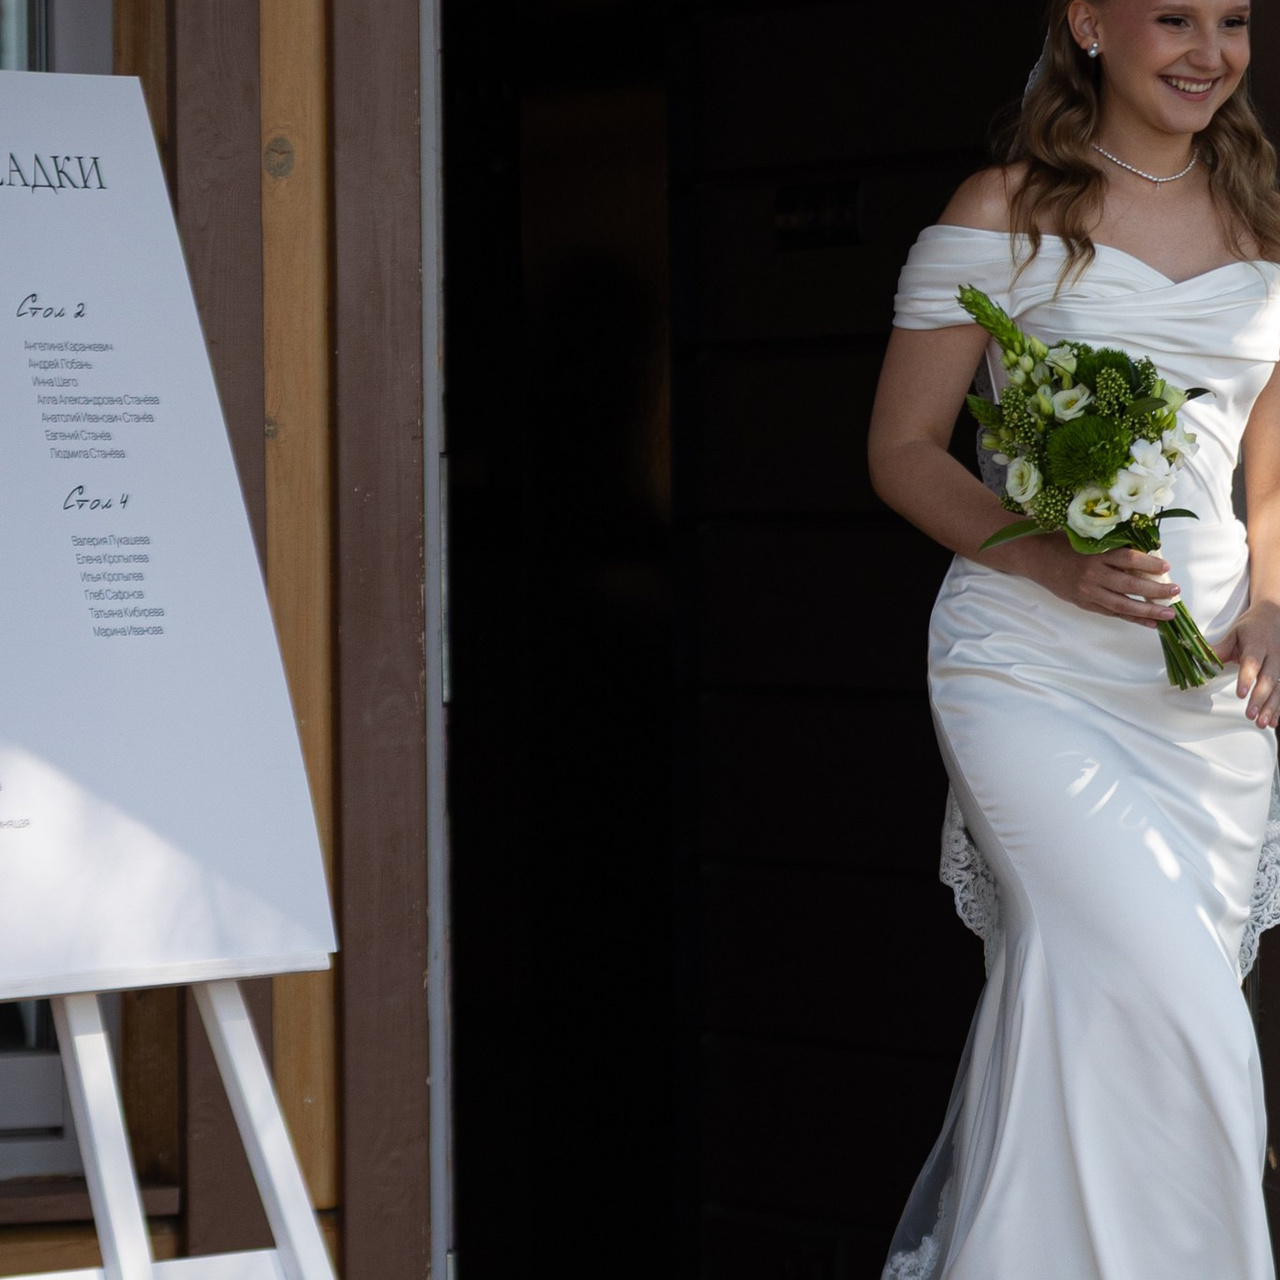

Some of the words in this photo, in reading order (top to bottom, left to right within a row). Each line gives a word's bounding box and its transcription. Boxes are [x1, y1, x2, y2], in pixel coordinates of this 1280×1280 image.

[0, 152, 107, 195] АДКИ
[16, 293, 65, 318] Стол
[74, 303, 86, 318] 2
[24, 341, 63, 351] Ангелина
[28, 358, 60, 371] Андрей
[31, 376, 54, 387] Инна
[58, 394, 123, 407] Александровна
[41, 412, 81, 422] Анатолий
[81, 412, 122, 423] Иванович
[45, 429, 80, 441] Евгений
[50, 447, 89, 459] Людмила
[63, 485, 112, 510] Стол
[119, 493, 129, 509] 4
[71, 535, 108, 548] Валерия
[75, 553, 102, 564] Елена
[80, 571, 101, 583] Илья
[84, 589, 105, 600] Глеб
[105, 589, 144, 602] Сафонов
[88, 607, 123, 619] Татьяна
[92, 626, 127, 638] Марина
[127, 625, 164, 636] Иванова
